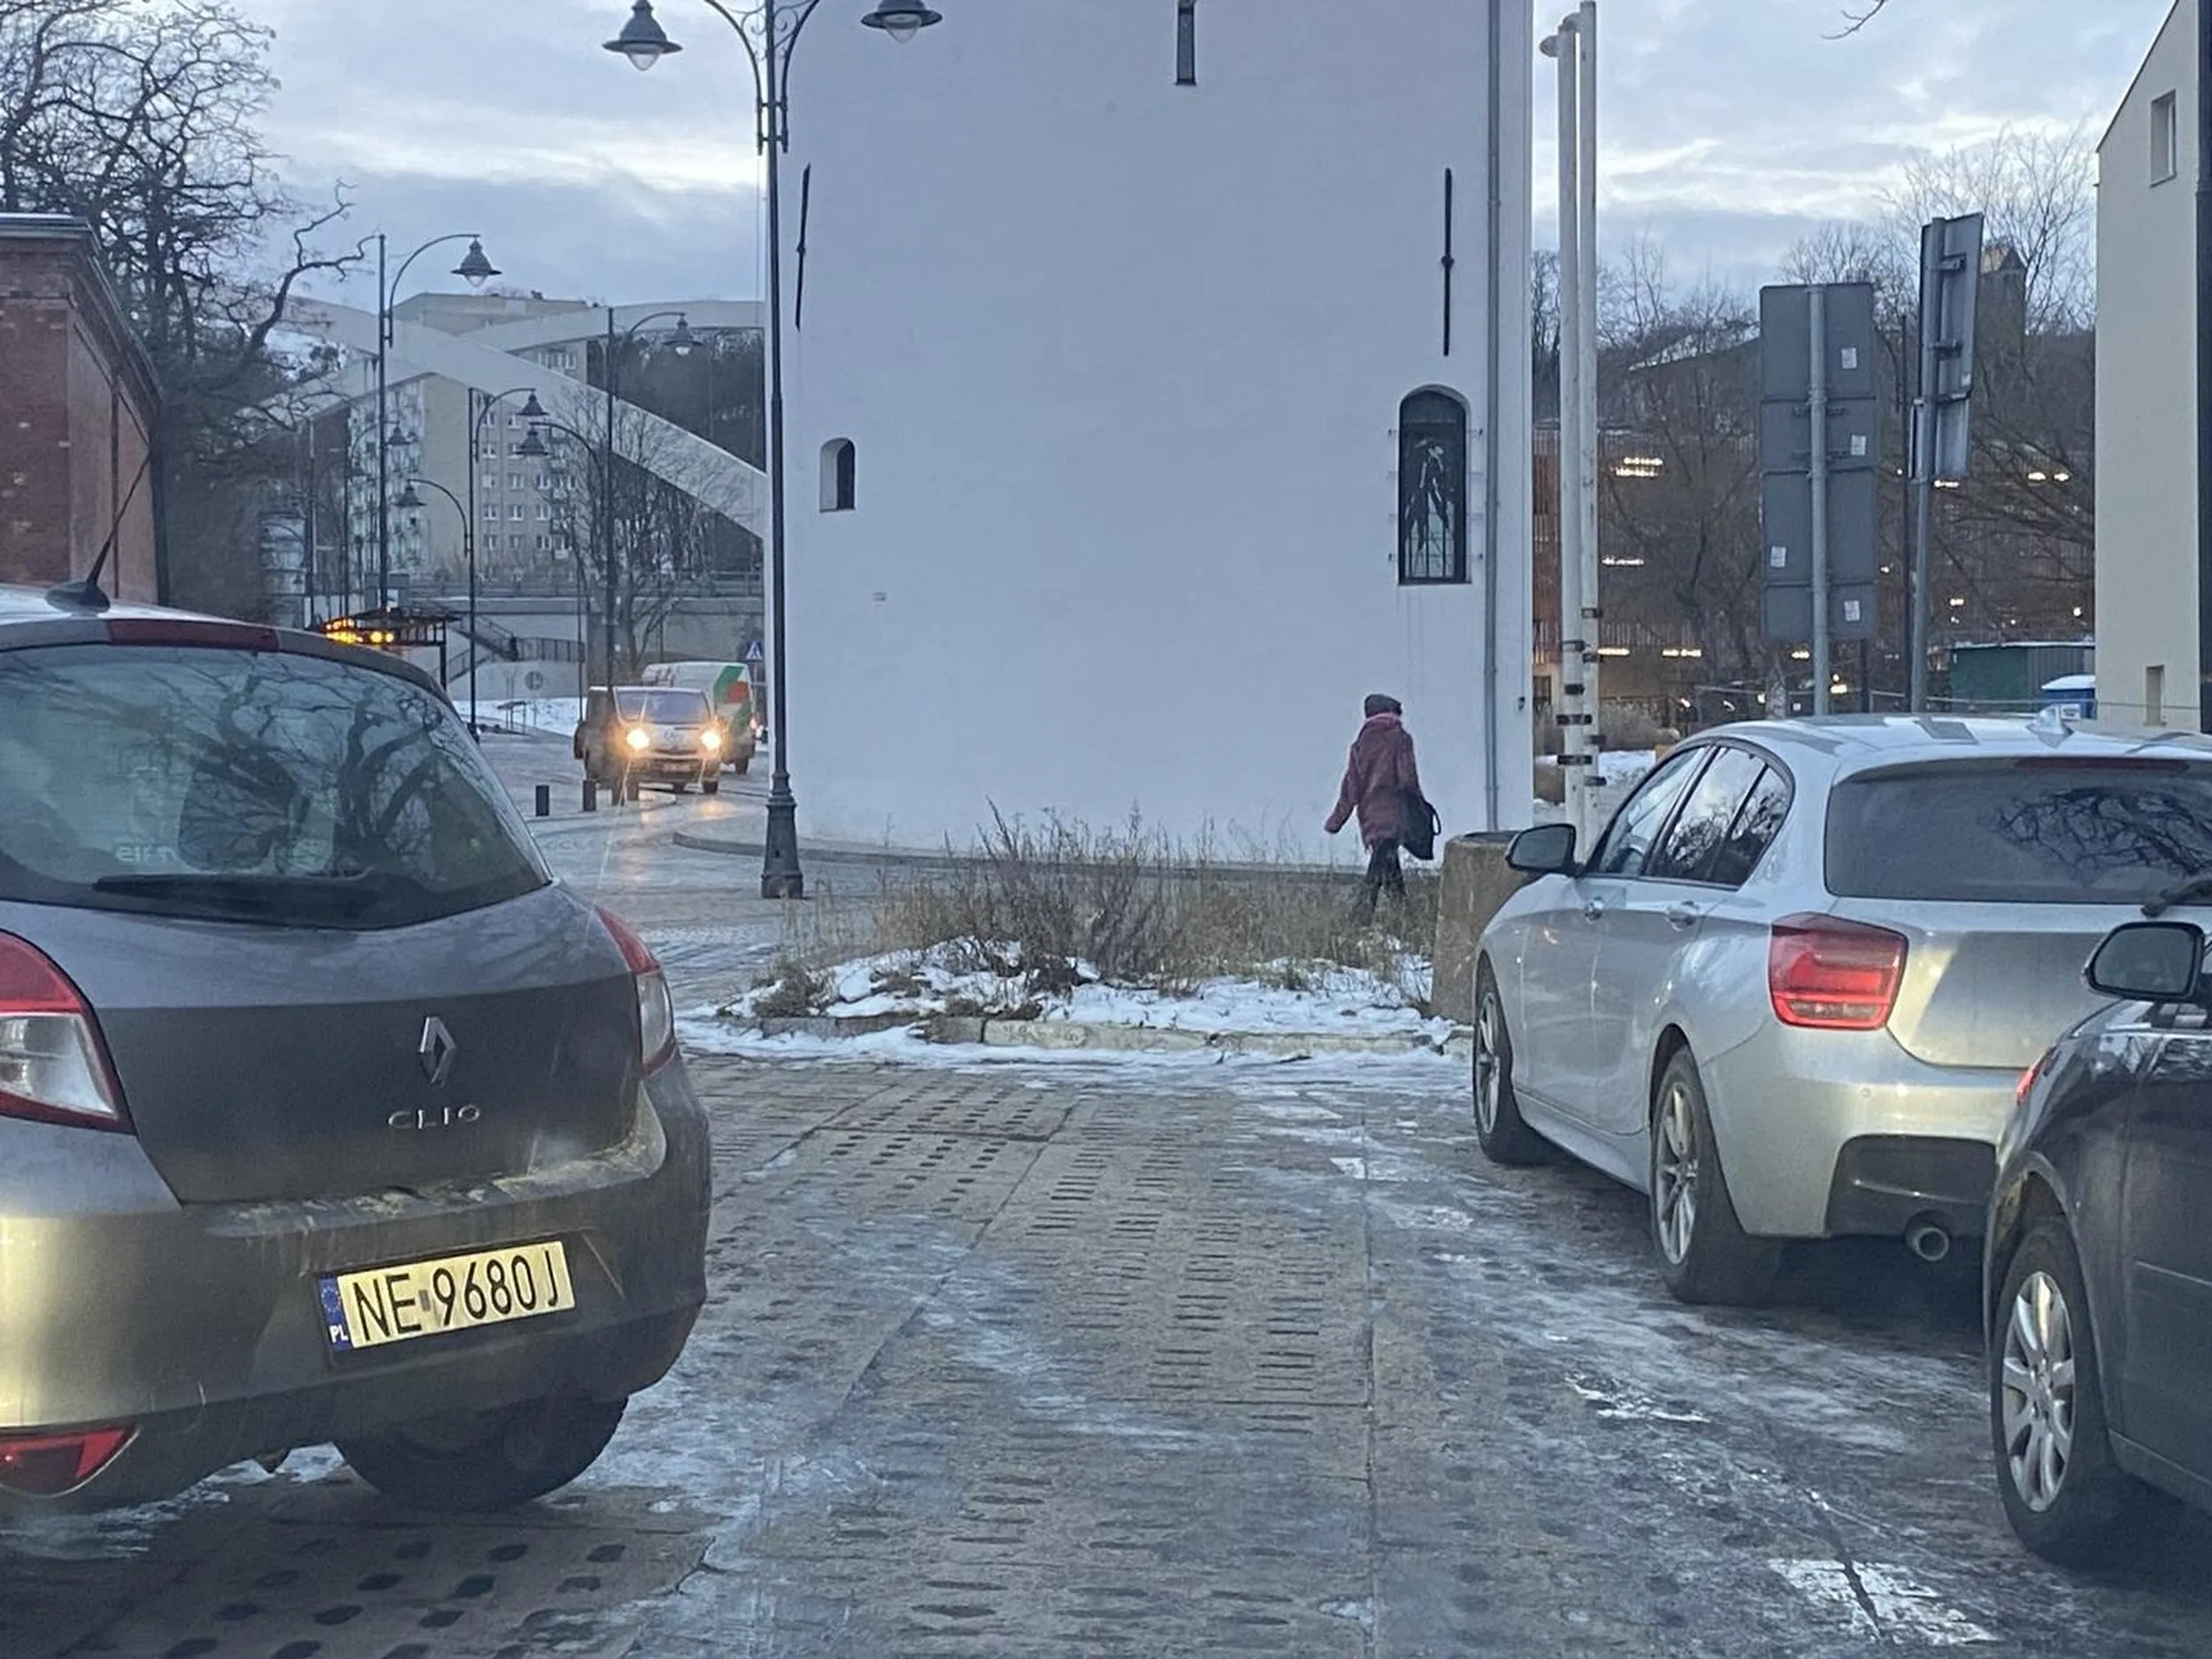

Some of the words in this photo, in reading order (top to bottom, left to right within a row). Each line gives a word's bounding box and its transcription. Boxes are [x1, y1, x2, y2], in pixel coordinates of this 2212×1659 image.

[388, 1104, 480, 1130] CLIO
[352, 1272, 422, 1341] NE
[432, 1250, 559, 1327] 9680J
[330, 1325, 349, 1343] PL
